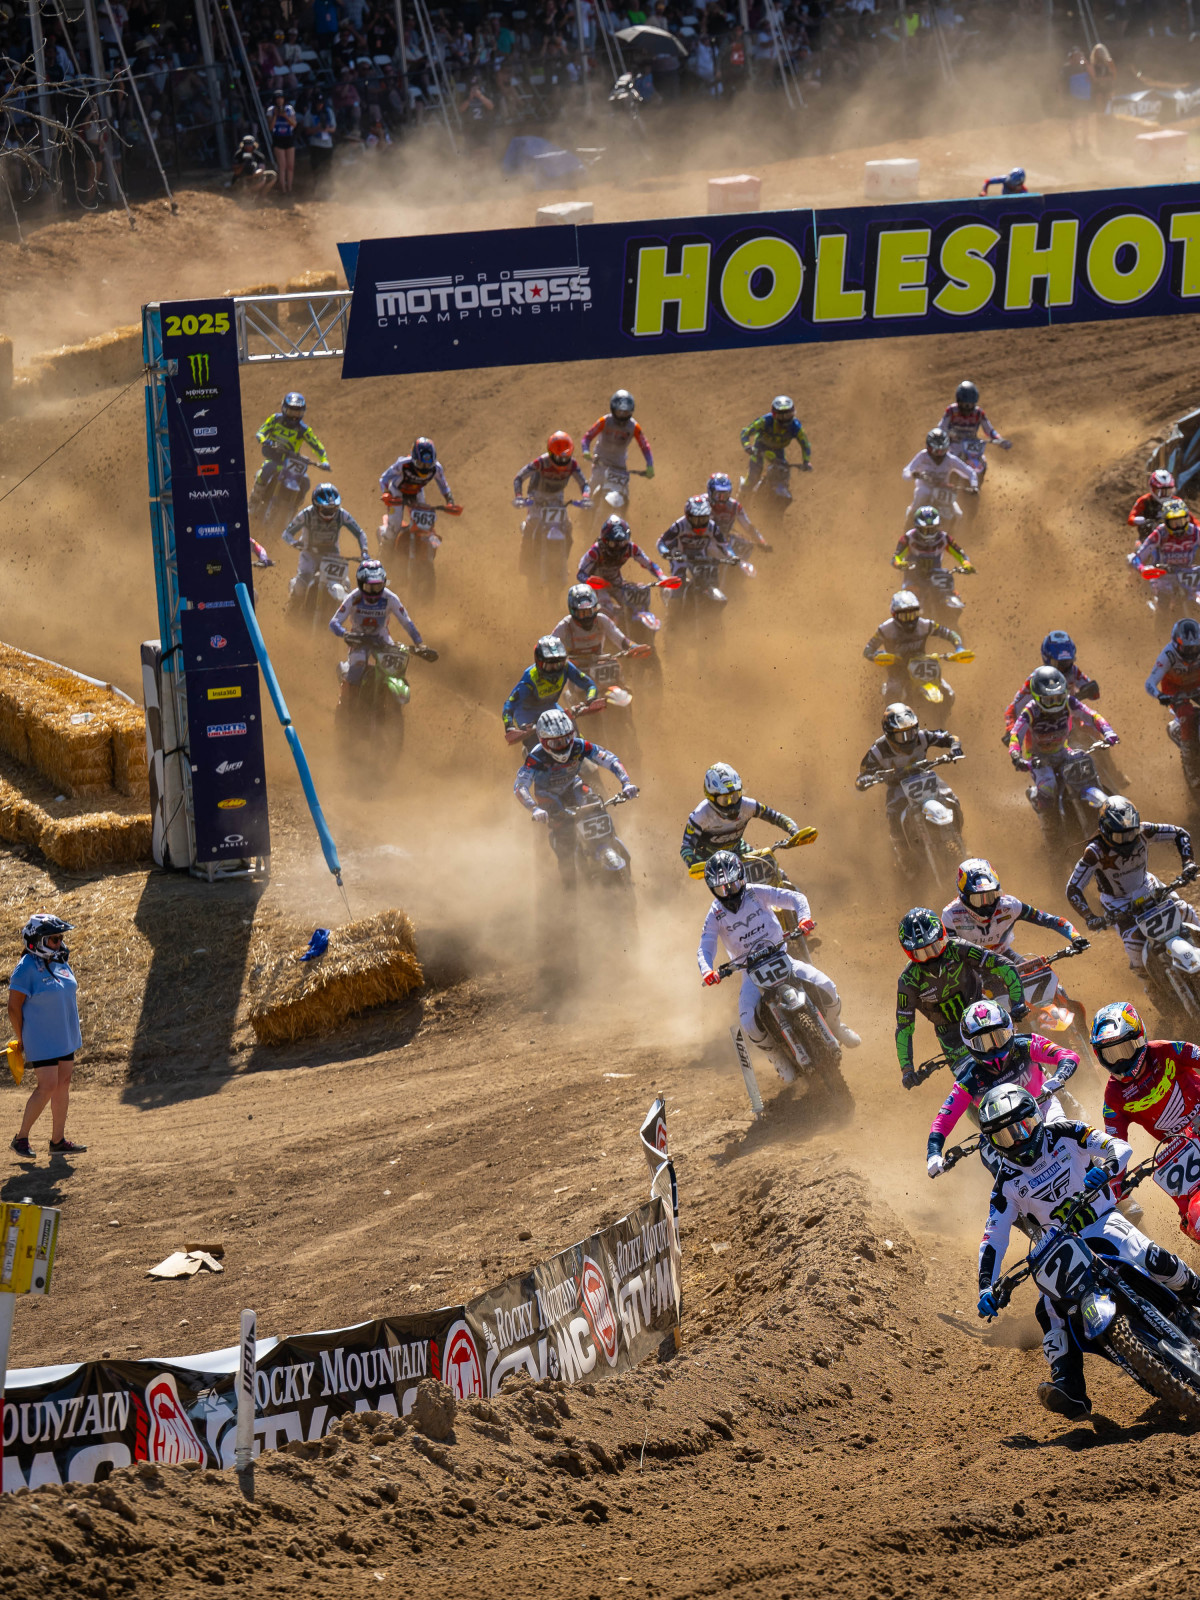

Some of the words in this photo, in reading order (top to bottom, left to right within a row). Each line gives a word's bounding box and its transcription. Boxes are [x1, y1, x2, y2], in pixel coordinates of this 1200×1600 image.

[455, 270, 511, 284] PRO
[375, 277, 592, 317] MOTOCROSS
[165, 312, 231, 337] 2025
[378, 302, 592, 327] CHAMPIONSHIP
[185, 388, 219, 396] MONSTER
[188, 488, 230, 499] NAMURA
[413, 511, 436, 527] 563
[914, 660, 937, 678] 45
[212, 689, 237, 697] Insta360
[207, 722, 246, 733] PARTS
[908, 777, 938, 800] 24
[582, 818, 611, 839] 53
[1145, 904, 1177, 939] 27
[754, 957, 789, 985] 42
[1157, 1139, 1184, 1164] RENTHAL
[1001, 1166, 1016, 1175] FLY
[1036, 1161, 1062, 1185] YAMAHA
[617, 1235, 642, 1278] ROCKY
[1044, 1243, 1087, 1298] 2
[494, 1300, 535, 1350] ROCKY
[535, 1276, 580, 1331] MOUNTAIN
[1141, 1303, 1180, 1340] DUNLOP
[556, 1316, 598, 1385] MC
[1104, 1344, 1140, 1382] DUNLOP
[235, 1362, 316, 1411] OCKY
[319, 1339, 430, 1398] MOUNTAIN
[0, 1390, 130, 1448] OUNTAIN
